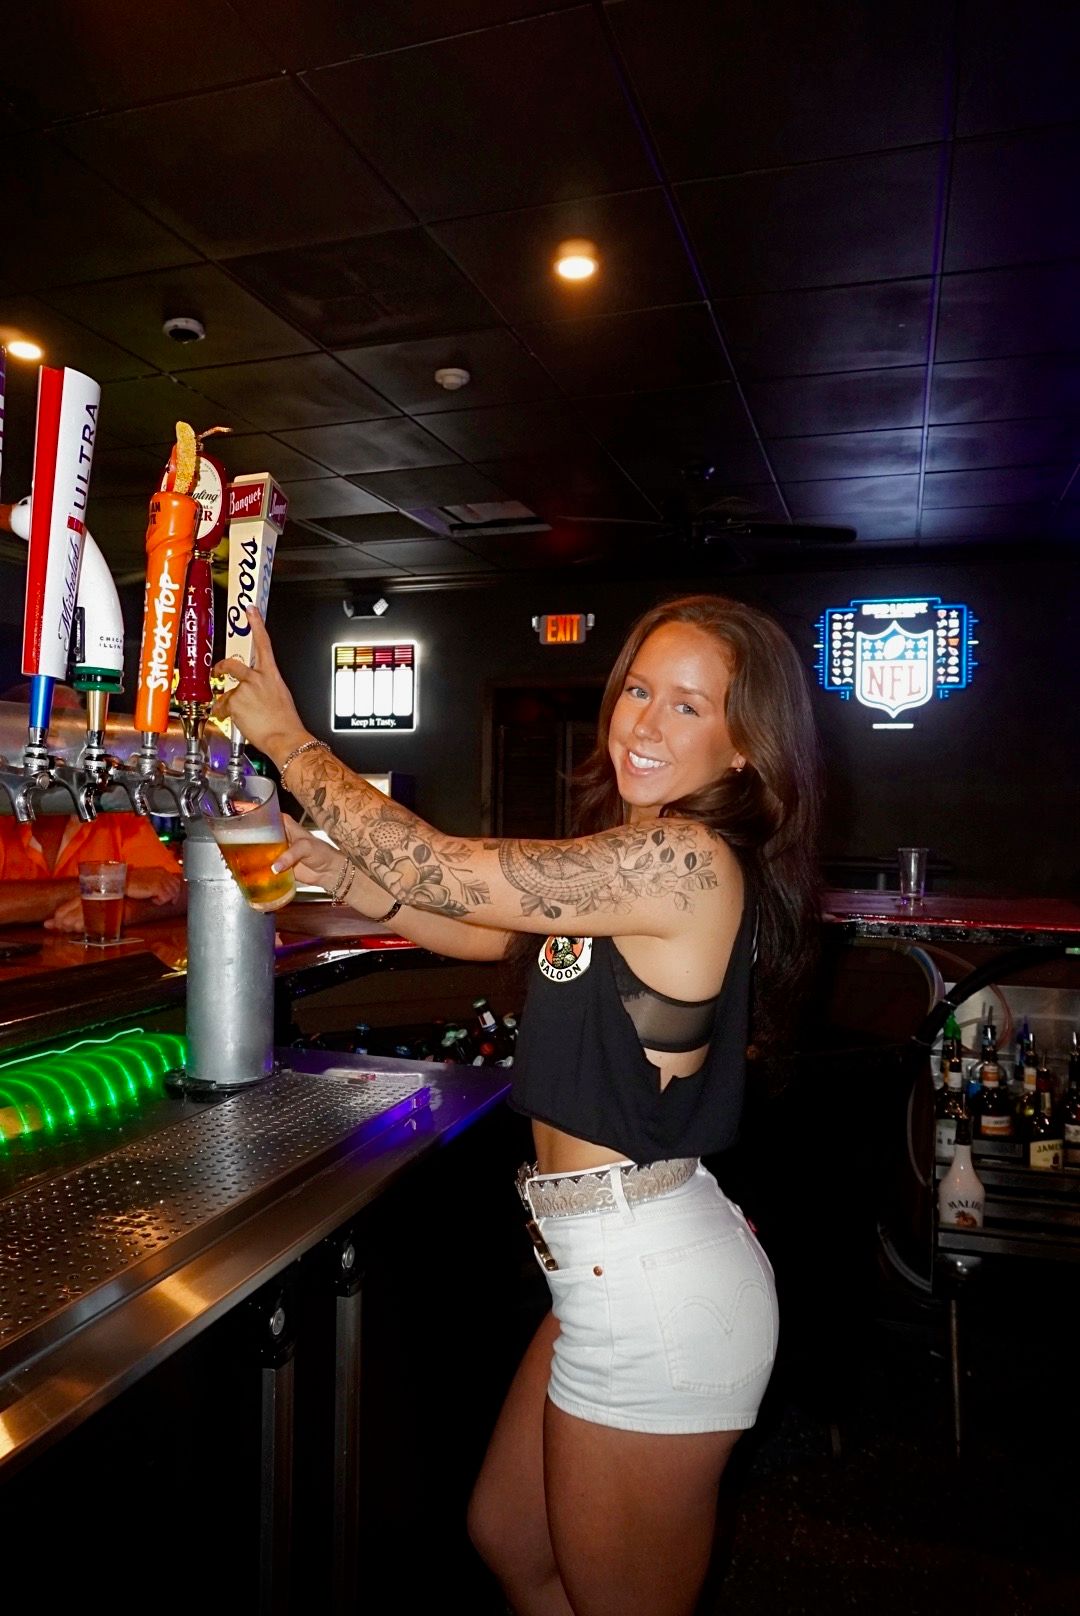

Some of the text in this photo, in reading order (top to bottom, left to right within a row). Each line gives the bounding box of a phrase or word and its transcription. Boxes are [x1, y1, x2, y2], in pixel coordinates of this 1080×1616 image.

[58, 403, 98, 652] Michelob ULTRA
[229, 487, 261, 515] Banquet
[228, 536, 258, 638] Coors
[260, 544, 274, 618] oors
[146, 566, 180, 692] SHOCK TOP
[185, 595, 198, 658] LAGER
[546, 614, 581, 642] EXIT
[867, 665, 921, 701] NFL
[540, 959, 582, 980] SALOON
